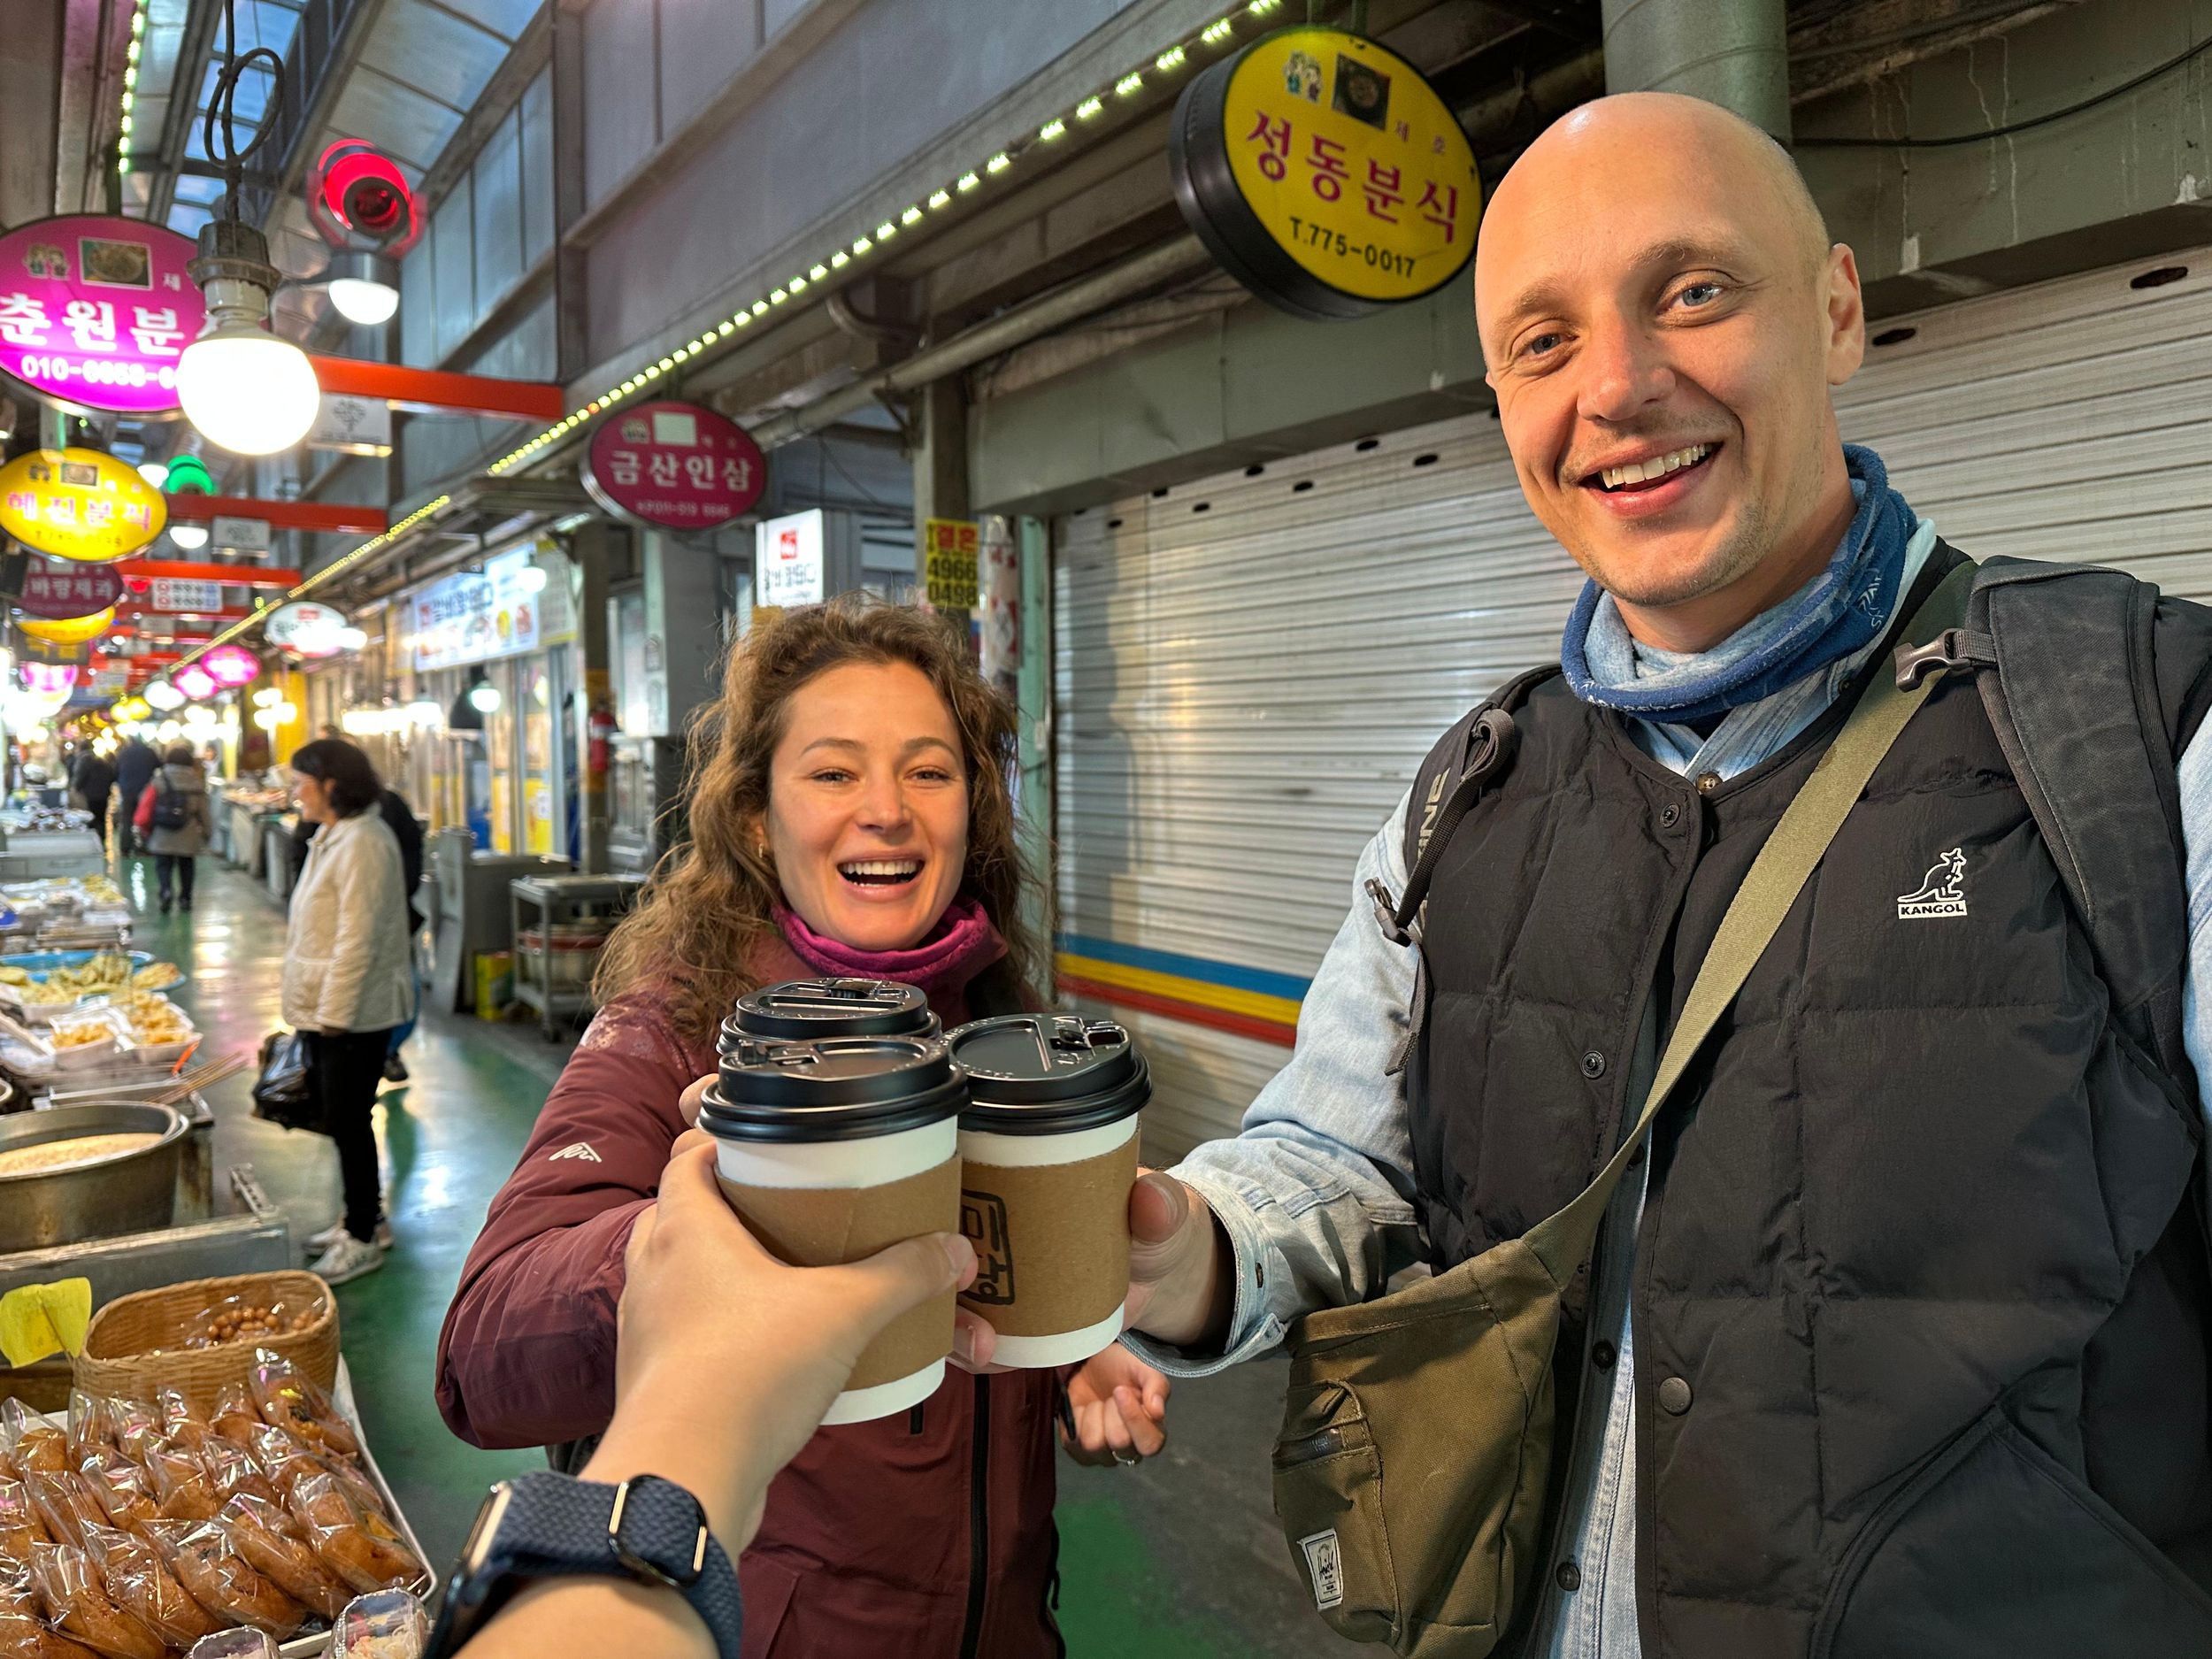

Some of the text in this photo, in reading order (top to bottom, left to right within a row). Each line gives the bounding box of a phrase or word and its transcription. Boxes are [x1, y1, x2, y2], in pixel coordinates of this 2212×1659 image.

[1247, 109, 1458, 244] 성동분식
[1289, 217, 1416, 279] T.775-0017
[0, 293, 212, 357] 춘원분
[609, 449, 751, 492] 금산인삼
[1901, 903, 1964, 915] KANGOL
